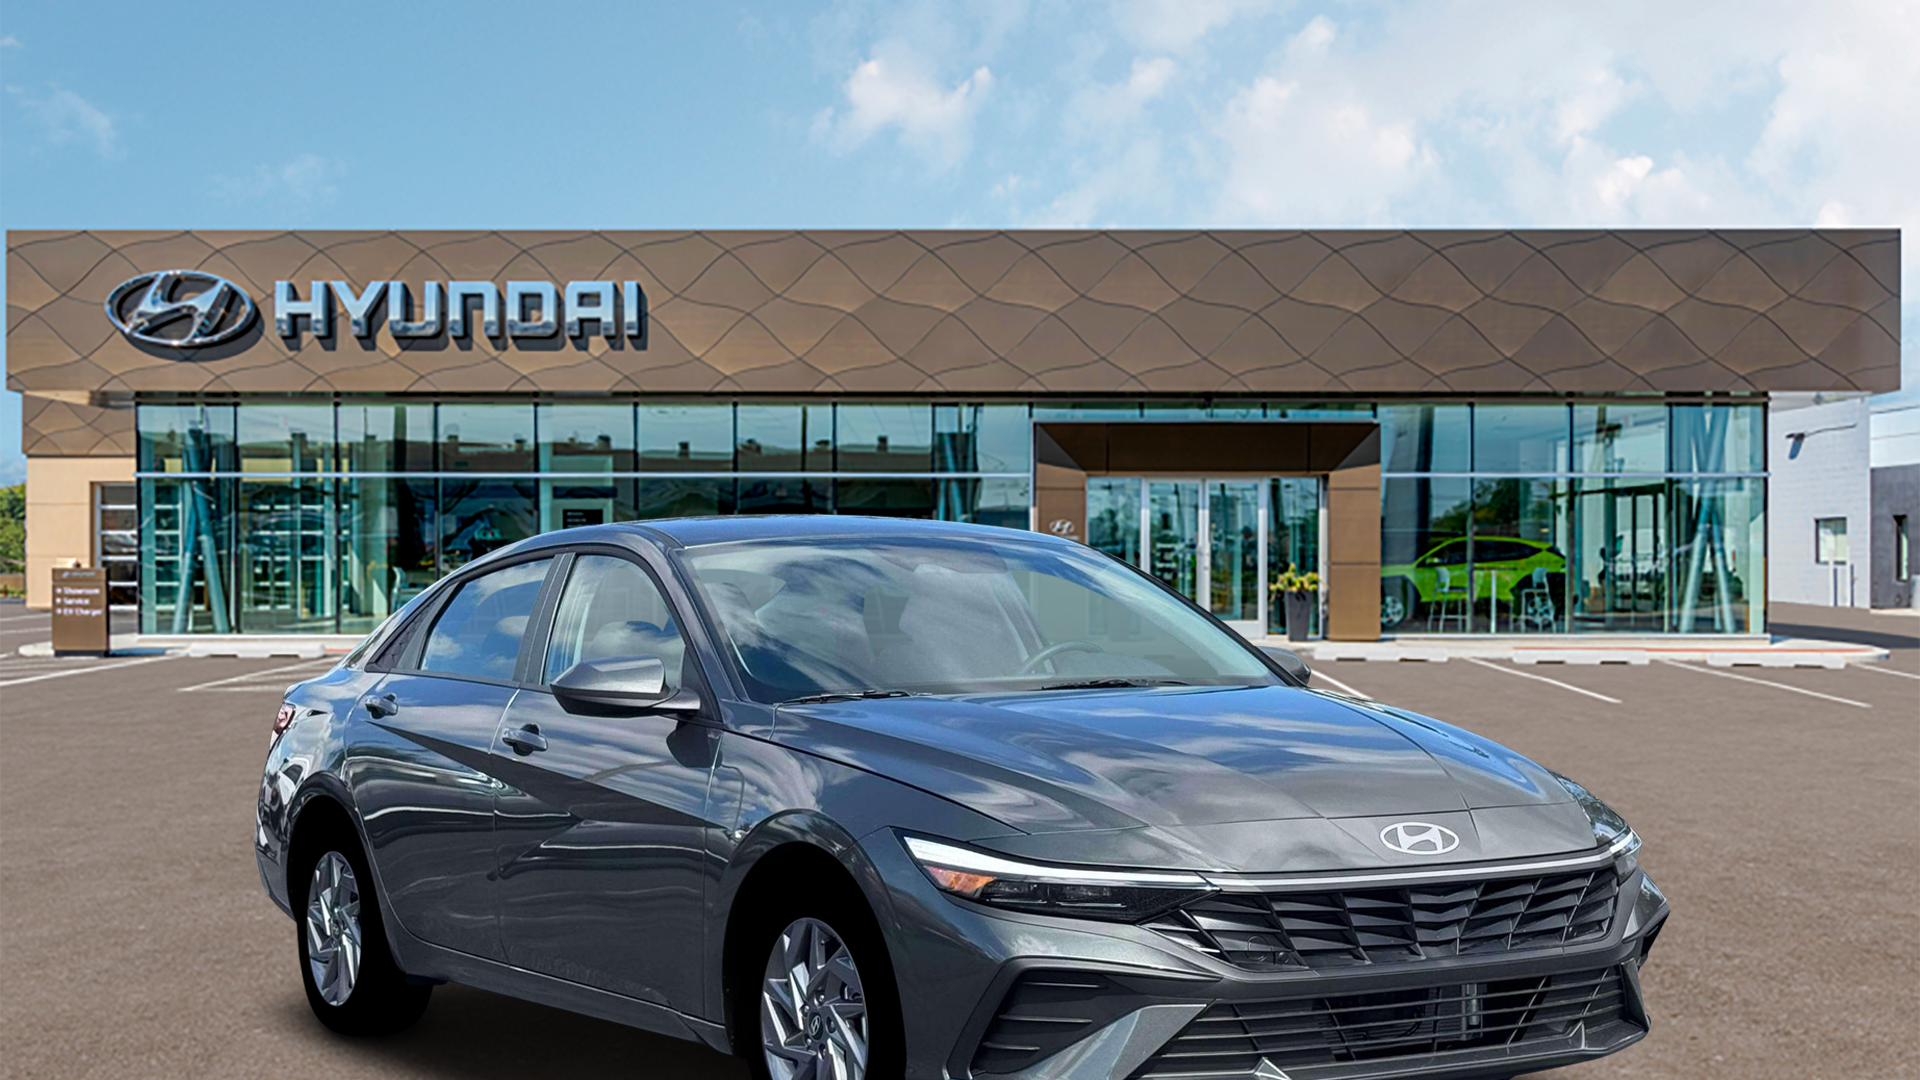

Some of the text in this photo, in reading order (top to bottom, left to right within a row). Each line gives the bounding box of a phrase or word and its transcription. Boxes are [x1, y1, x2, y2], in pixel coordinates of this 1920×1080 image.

[274, 280, 641, 340] HYUNDAI
[63, 586, 100, 595] Showroom
[63, 597, 90, 605] Service
[75, 608, 102, 617] Charger
